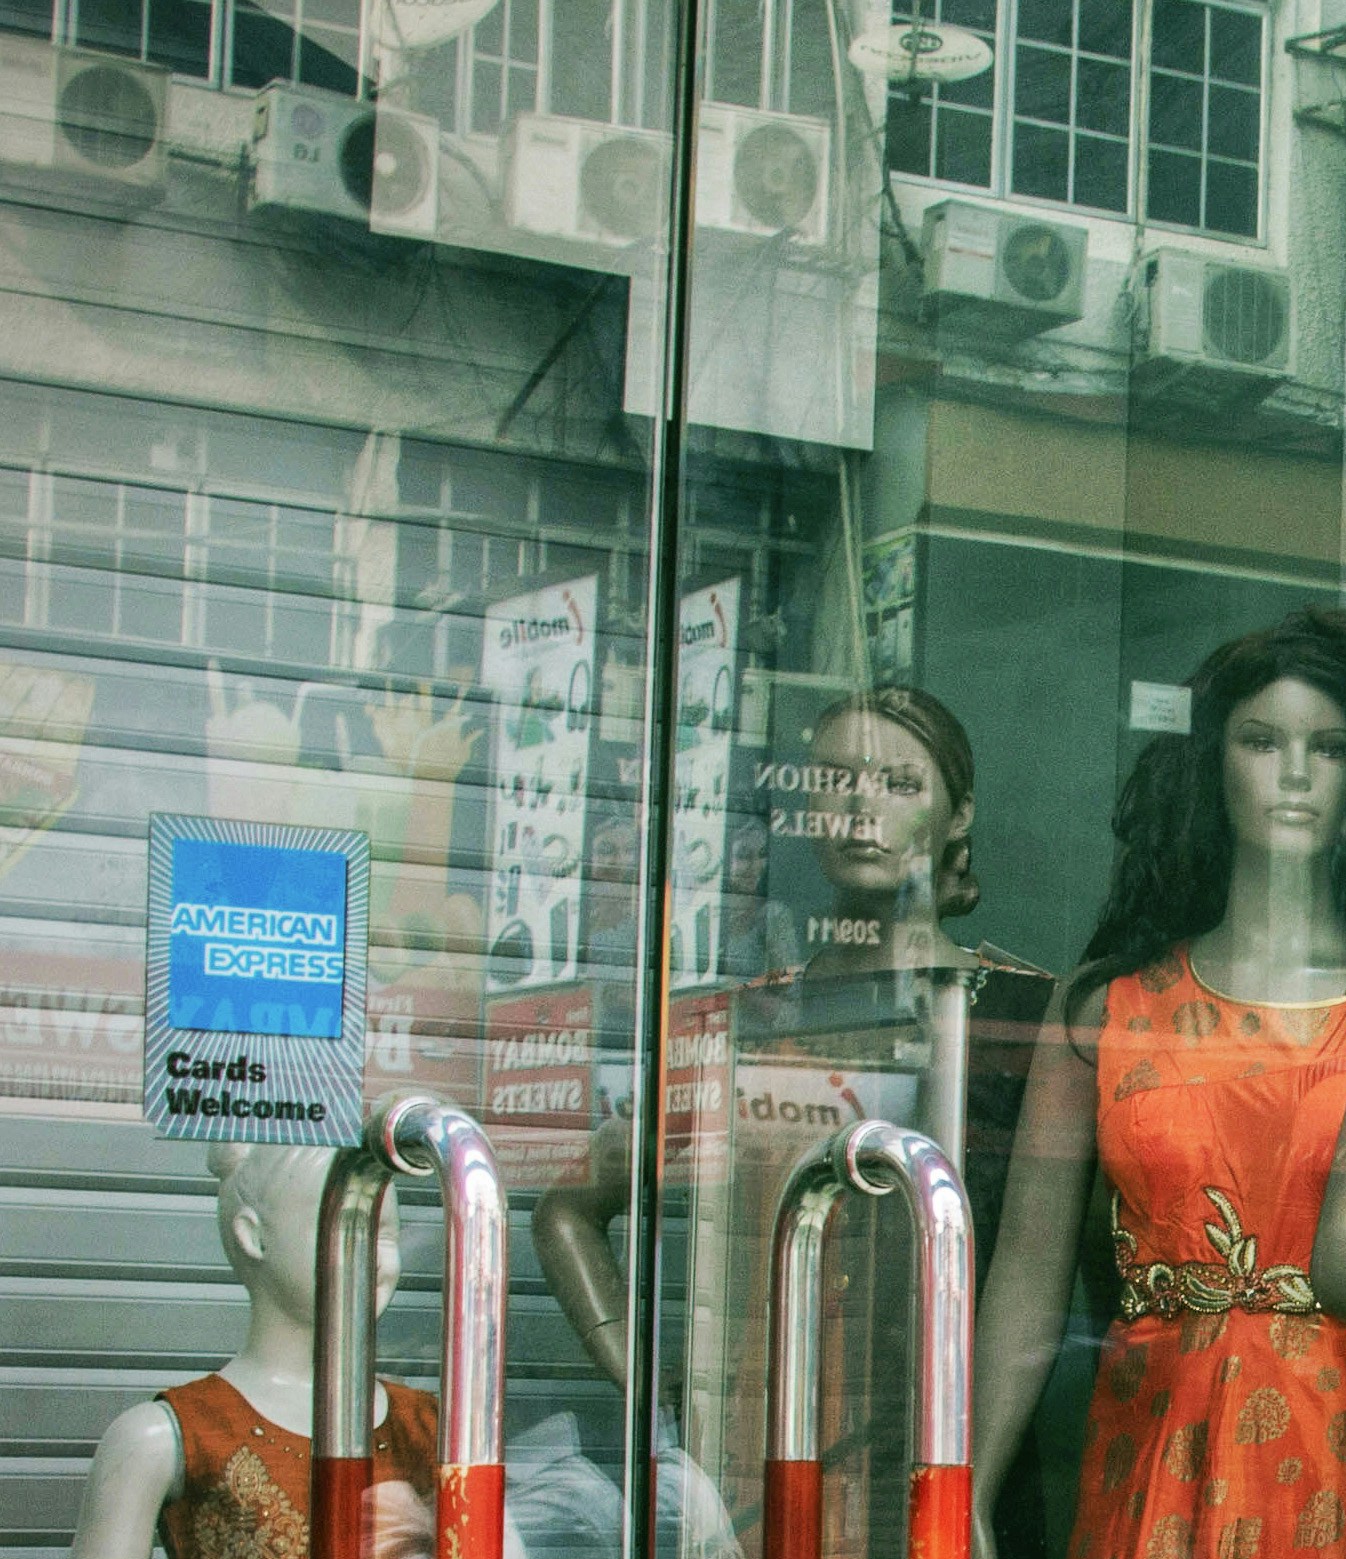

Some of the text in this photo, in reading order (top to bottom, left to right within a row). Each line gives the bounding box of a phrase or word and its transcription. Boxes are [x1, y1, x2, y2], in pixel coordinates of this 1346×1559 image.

[171, 903, 337, 945] AMERICAN
[204, 945, 344, 984] EXPRESS
[166, 1050, 267, 1084] Cards
[165, 1088, 327, 1123] Welcome
